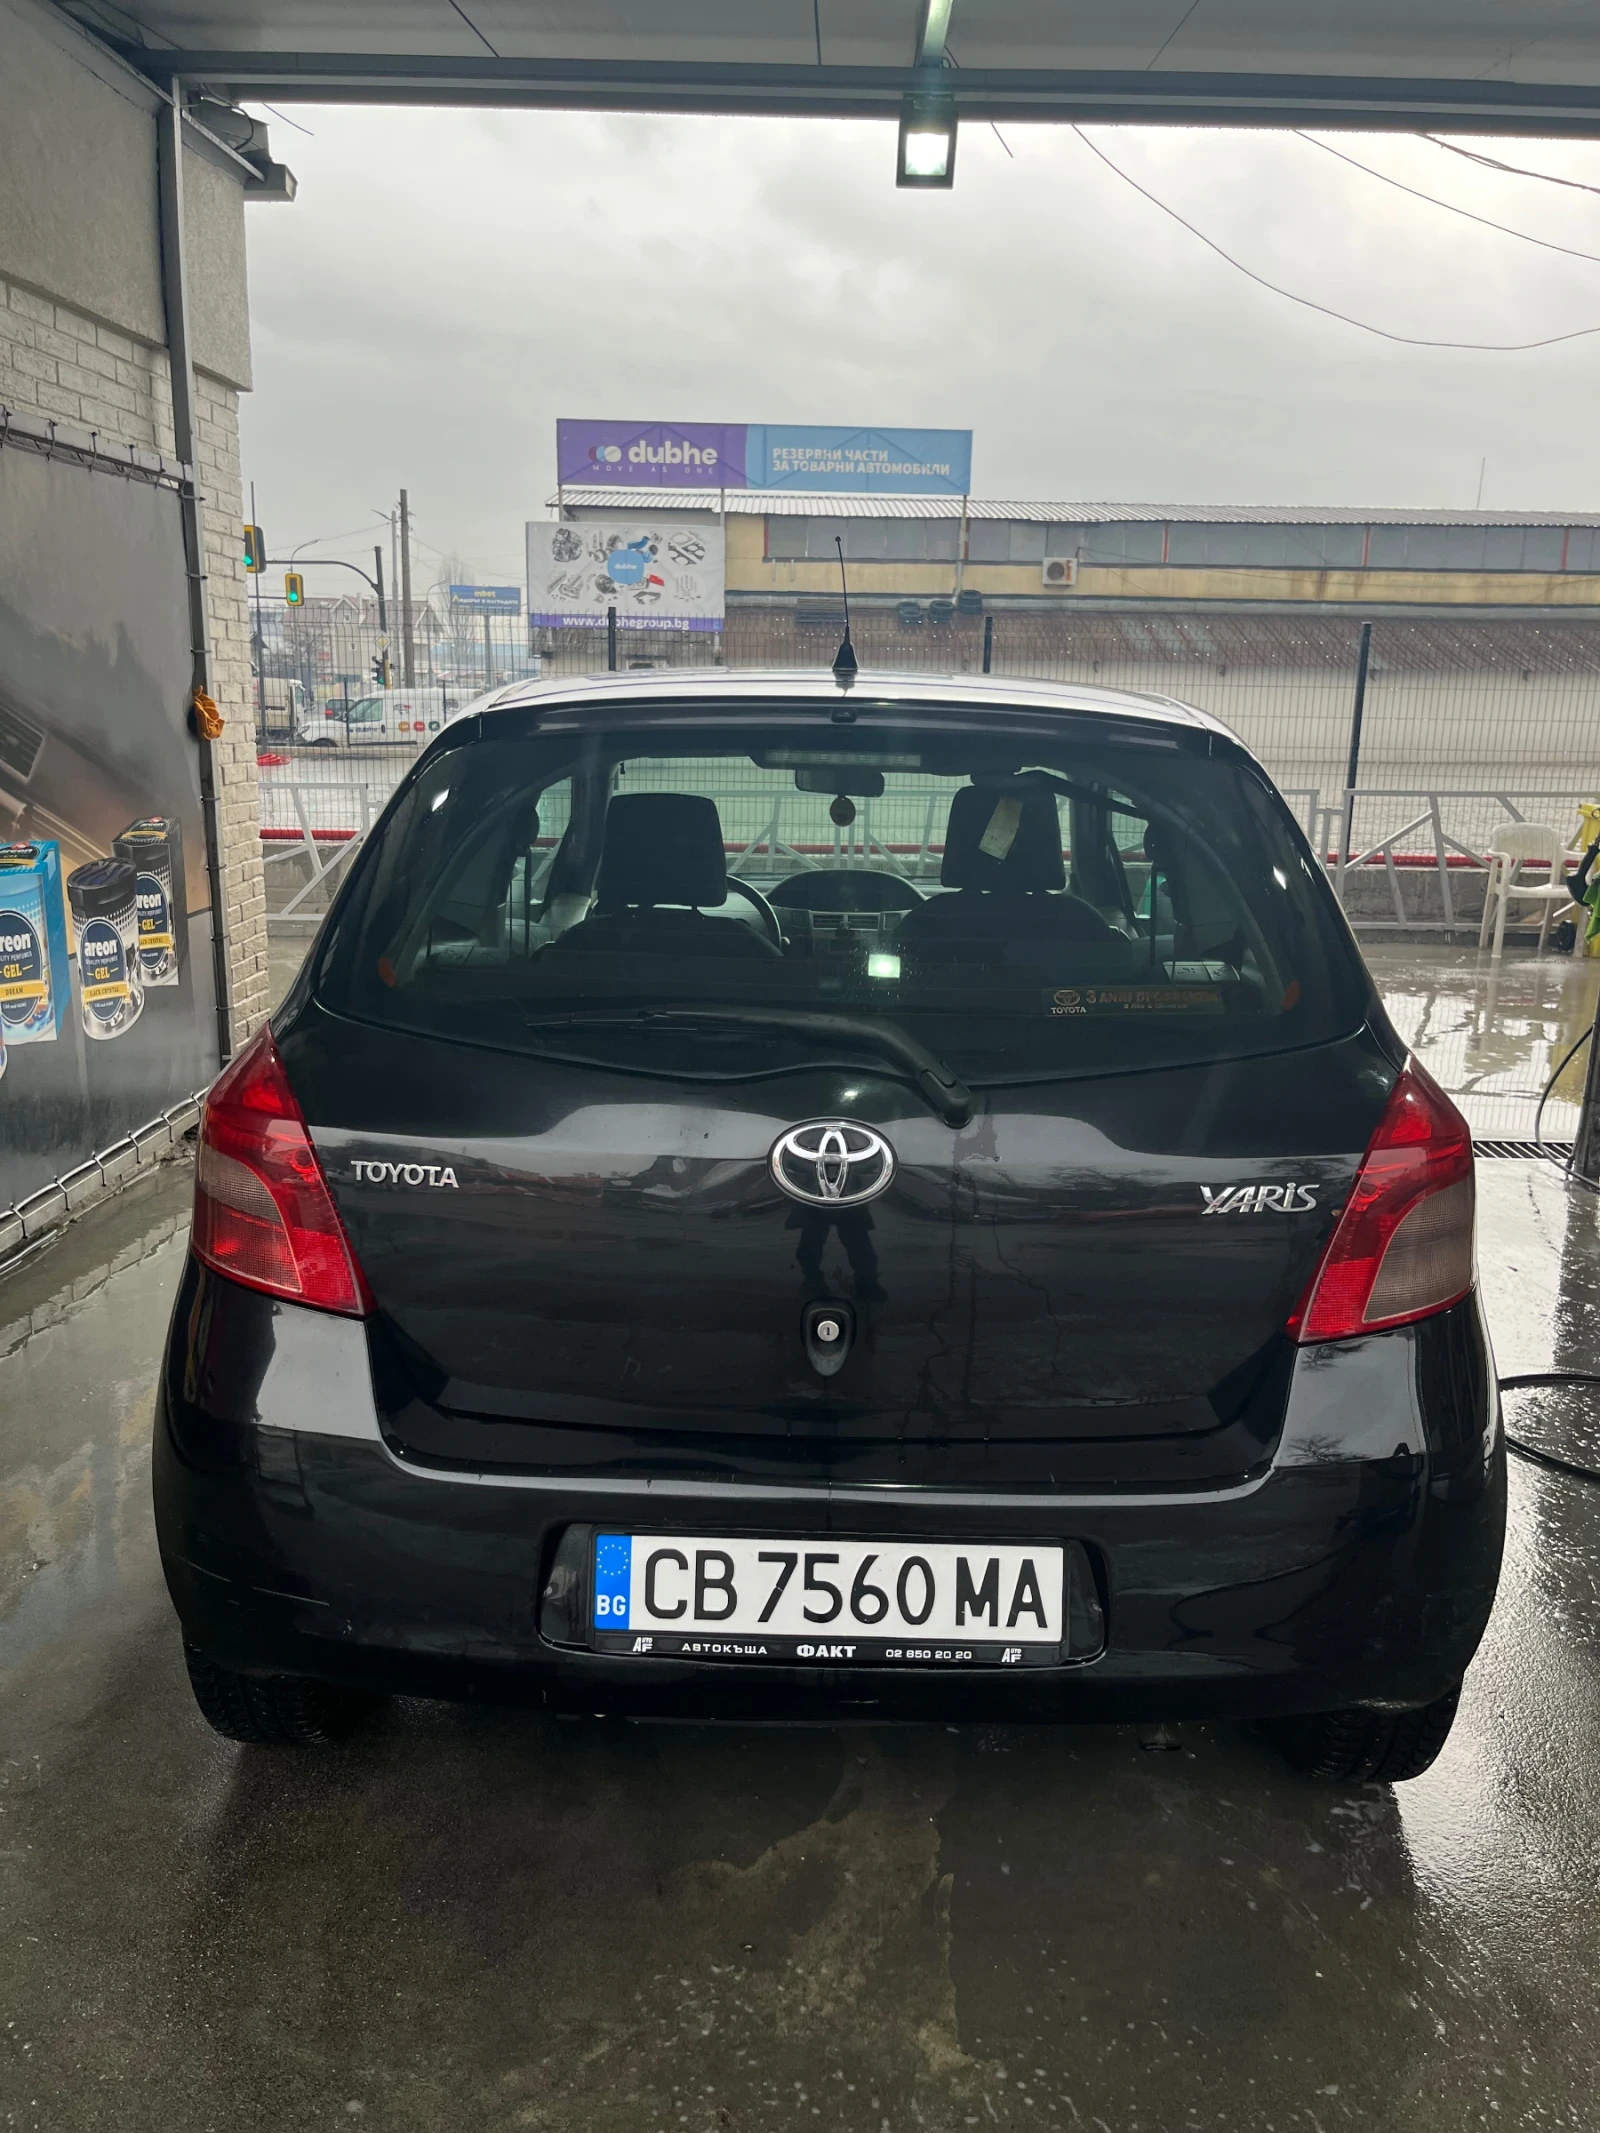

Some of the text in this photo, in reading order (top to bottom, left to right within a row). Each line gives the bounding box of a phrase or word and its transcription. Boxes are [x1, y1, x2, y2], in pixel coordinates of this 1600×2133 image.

[628, 440, 718, 465] dubhe
[772, 447, 889, 462] РЕЗЕРВНИ ЧАСТИ
[592, 465, 633, 473] MOVE
[684, 467, 713, 475] ONE
[772, 460, 950, 475] ЗА ТОВАРНИ АВТОМОБИЛИ
[0, 932, 31, 953] reon
[84, 940, 118, 957] areon
[3, 963, 23, 979] GEL
[94, 966, 111, 980] GEL
[5, 986, 24, 996] DREAM
[1085, 989, 1097, 1004] 3
[1050, 1006, 1087, 1015] TOYOTA
[350, 1160, 460, 1189] TOYOTA
[644, 1547, 1048, 1629] CB 7560 MA
[596, 1594, 626, 1616] BG
[681, 1643, 768, 1655] АВТОКЪША
[796, 1644, 857, 1658] ФАКТ
[885, 1649, 972, 1660] 02 850 20 20
